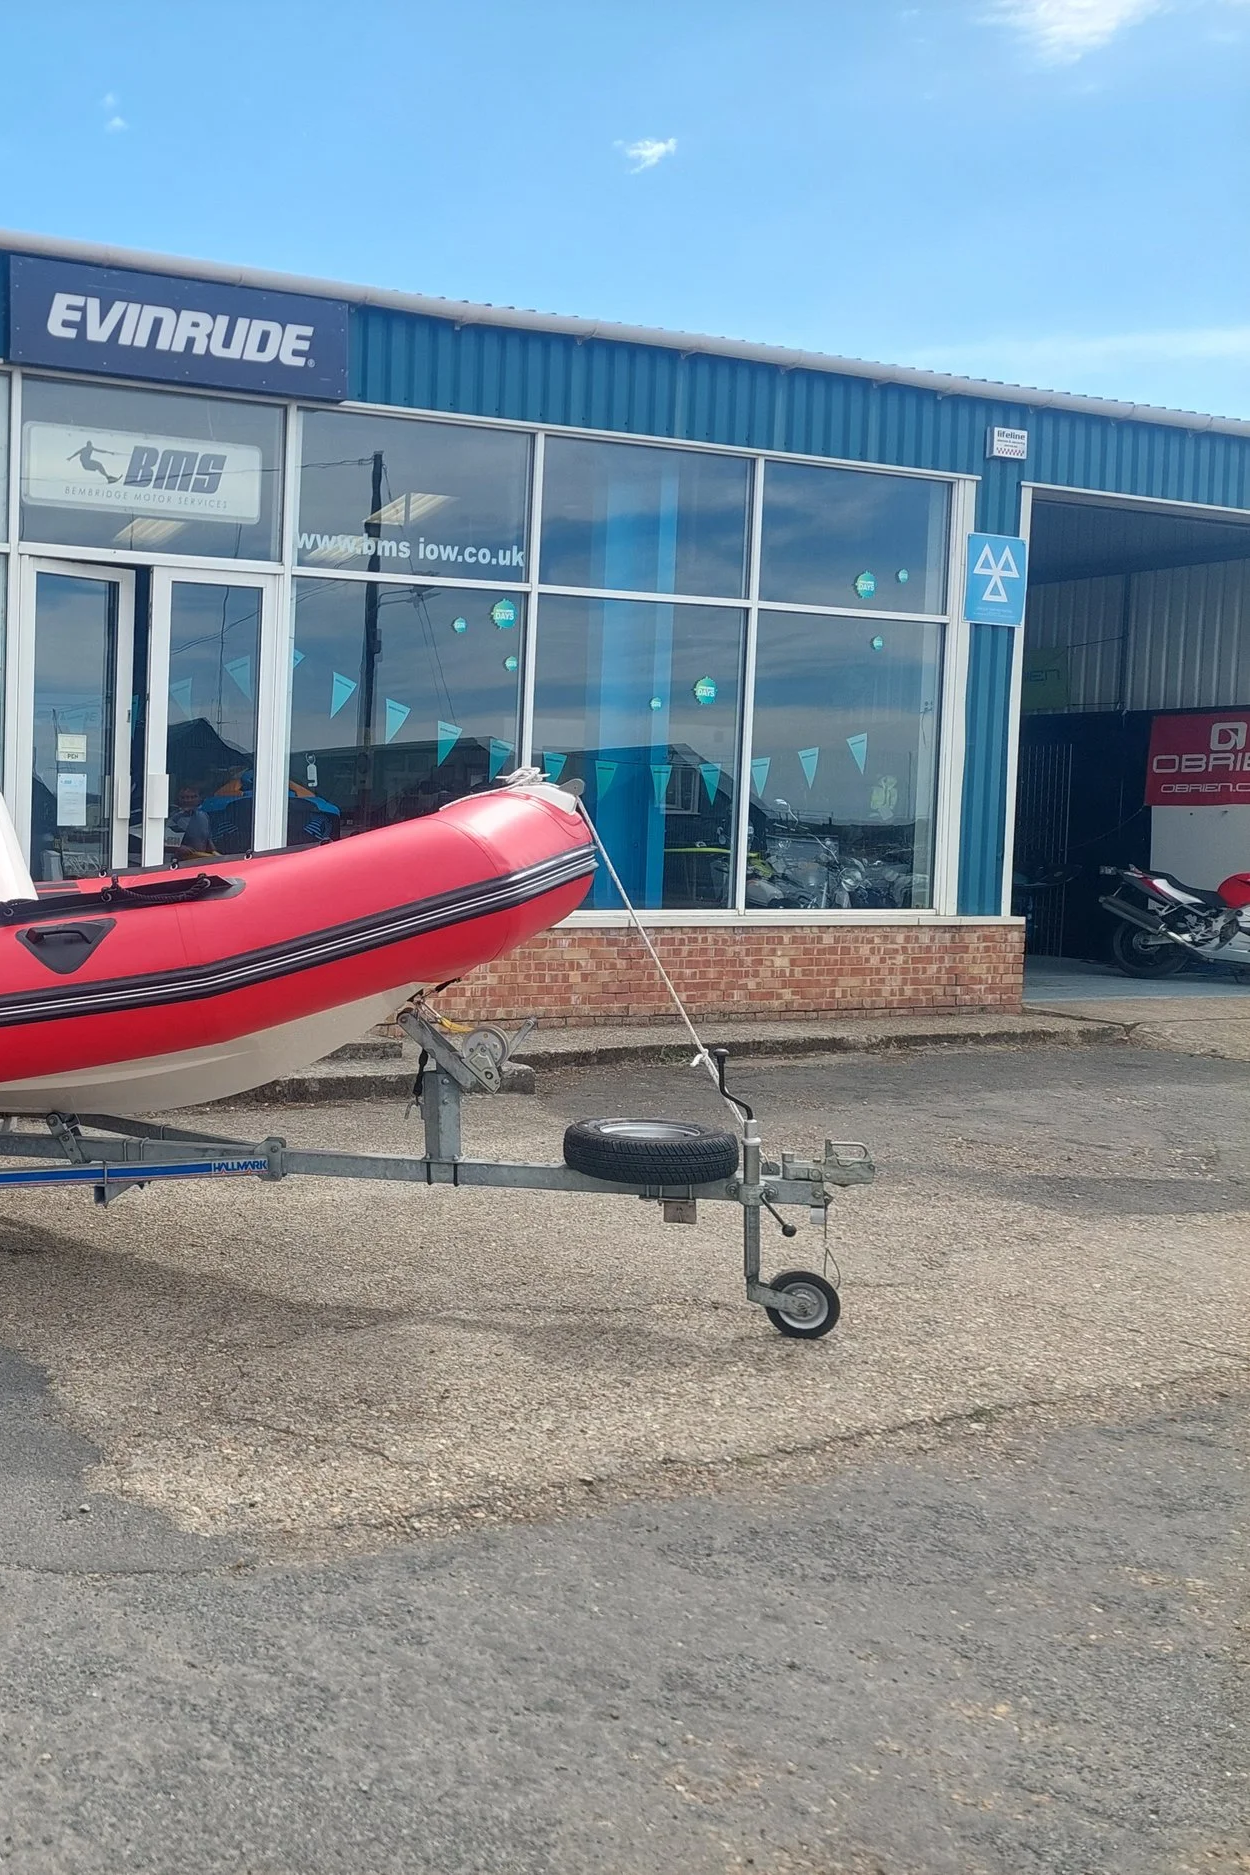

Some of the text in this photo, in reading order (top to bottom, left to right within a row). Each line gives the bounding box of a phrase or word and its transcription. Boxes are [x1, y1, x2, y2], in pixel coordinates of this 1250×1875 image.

[47, 292, 314, 367] EVINRUDE
[997, 430, 1025, 440] lifeline
[123, 445, 227, 494] BMS
[64, 486, 228, 509] BEMBRIDGE MOTOR SERVICES
[495, 612, 515, 621] DAYS
[697, 688, 716, 698] DAYS
[212, 1159, 268, 1173] HALLMARK
